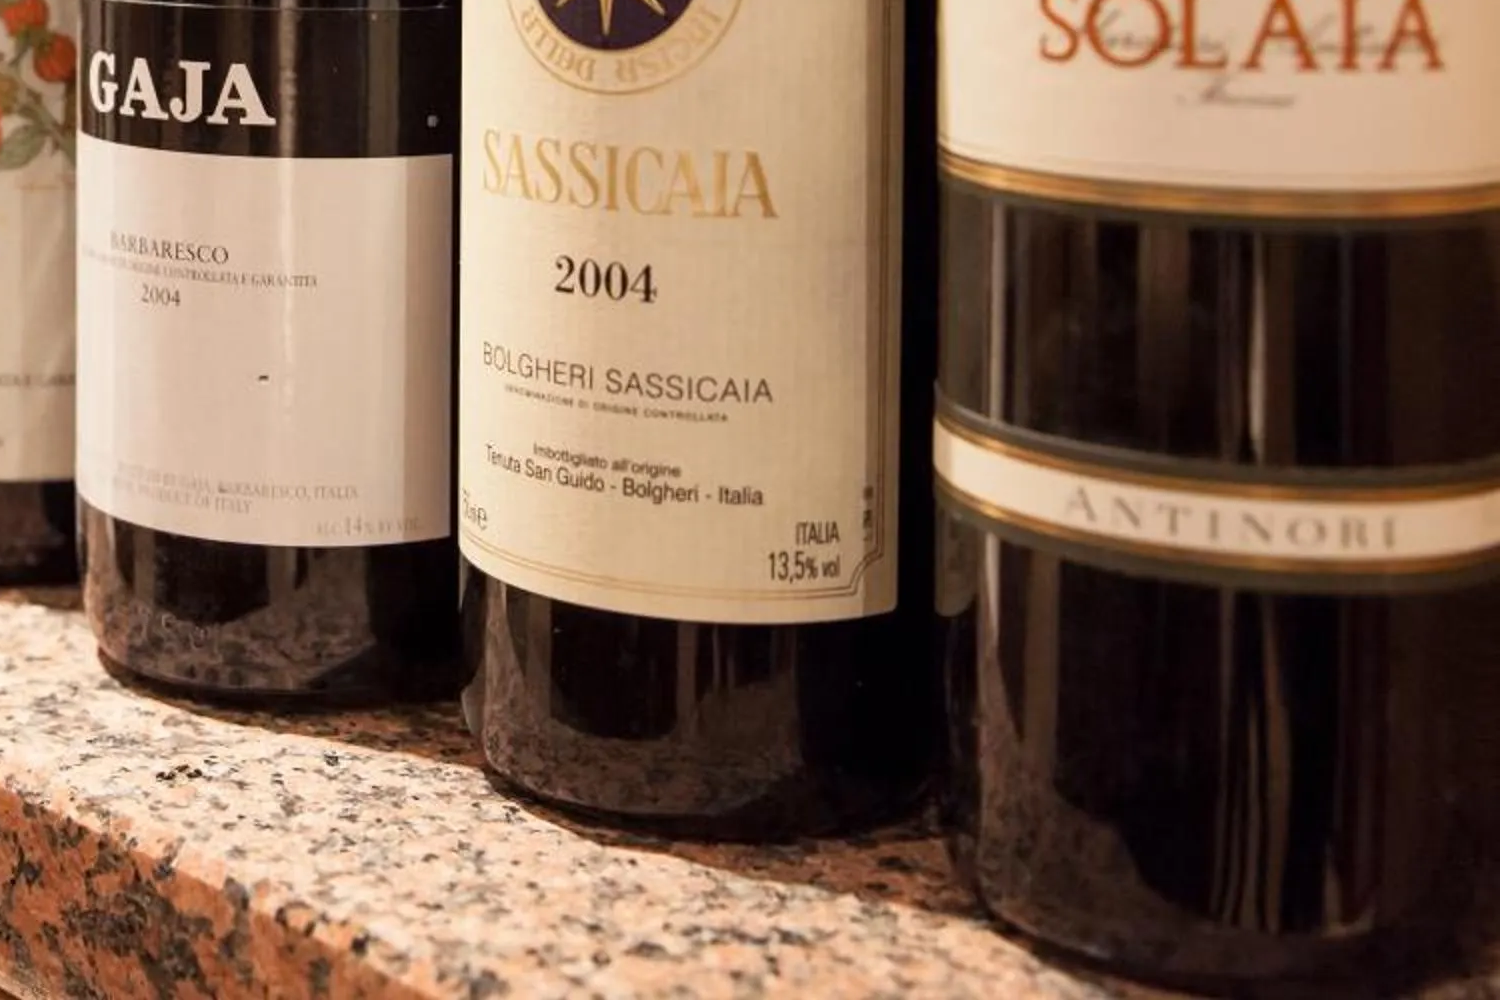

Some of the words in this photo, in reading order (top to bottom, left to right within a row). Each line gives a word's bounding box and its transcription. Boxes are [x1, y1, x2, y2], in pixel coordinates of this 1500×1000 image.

[88, 50, 277, 127] GAJA
[483, 128, 779, 220] SASSICAIA
[110, 231, 229, 265] BARBARESCO
[141, 283, 181, 307] 2004
[555, 255, 658, 304] 2004
[484, 341, 594, 390] BOLGHERI
[606, 367, 774, 403] SASSICAIA
[485, 443, 521, 474] Tenuta
[525, 458, 551, 483] San
[556, 465, 605, 493] Guido
[622, 477, 699, 506] Bolgheri
[718, 485, 764, 506] Italia
[796, 521, 840, 545] ITALIA
[1065, 483, 1398, 550] ANTINORI
[769, 551, 818, 584] 13,5%
[822, 553, 841, 578] vol
